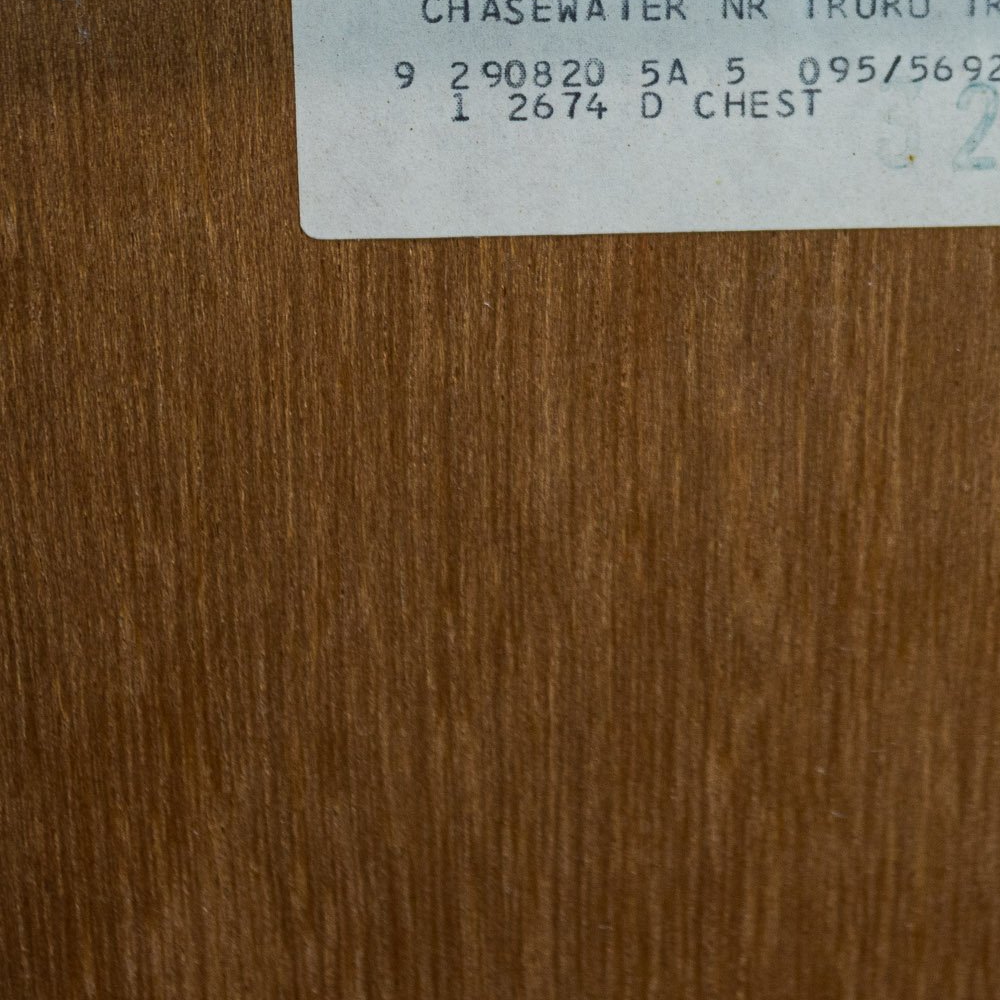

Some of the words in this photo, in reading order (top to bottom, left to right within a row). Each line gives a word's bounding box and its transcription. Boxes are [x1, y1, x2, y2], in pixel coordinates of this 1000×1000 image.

[393, 60, 416, 90] 9
[450, 57, 606, 90] 290820
[640, 57, 689, 89] 5A
[726, 56, 746, 86] 5
[451, 92, 471, 123] 1
[507, 90, 609, 123] 2674
[640, 90, 664, 120] D
[693, 87, 823, 120] CHEST
